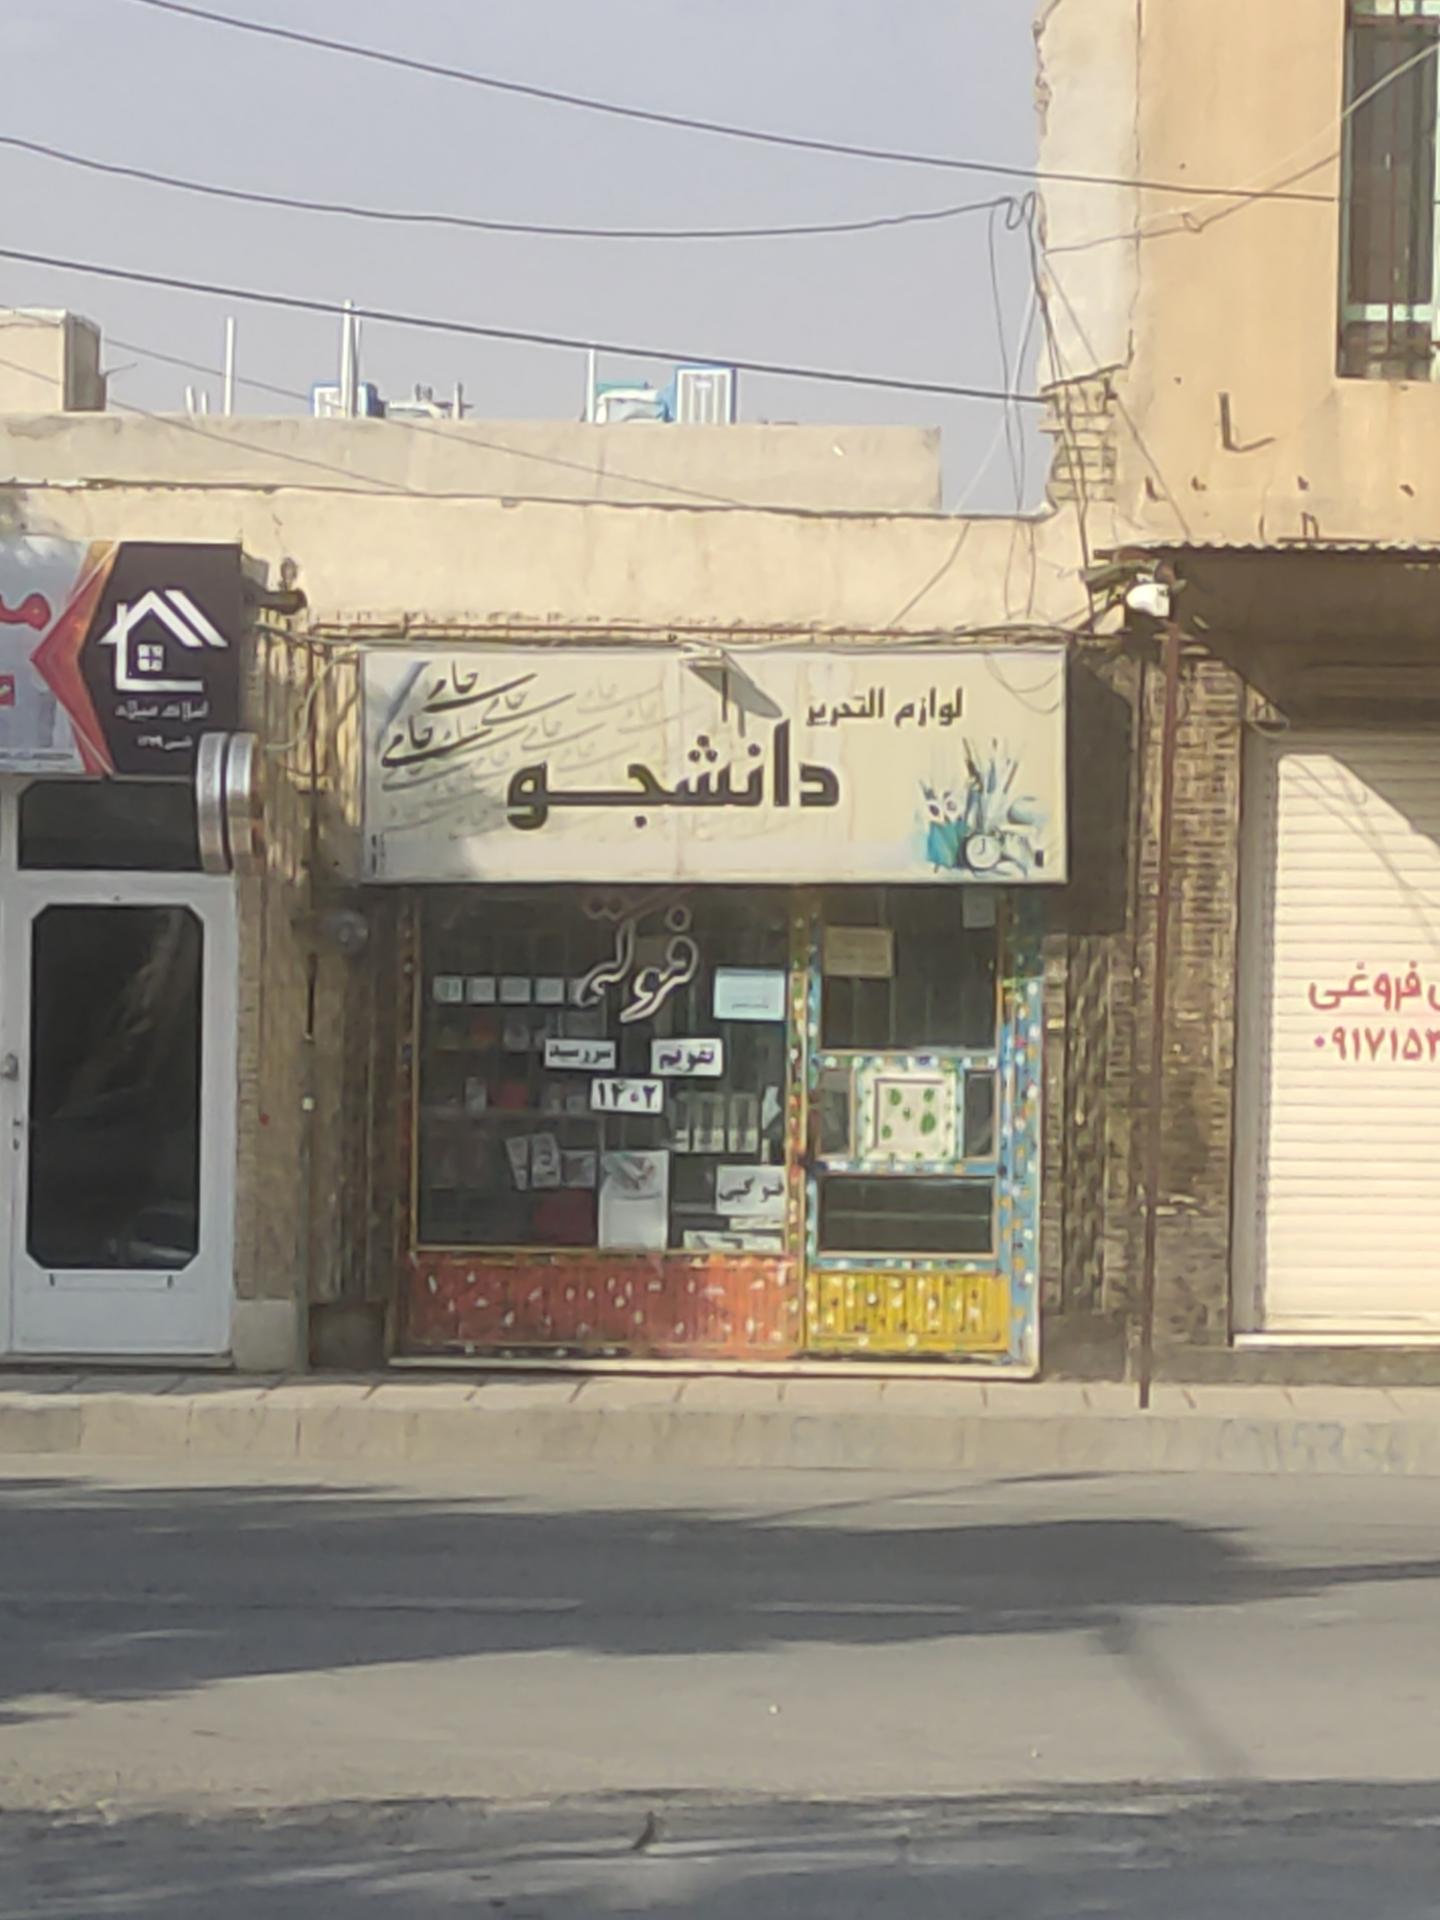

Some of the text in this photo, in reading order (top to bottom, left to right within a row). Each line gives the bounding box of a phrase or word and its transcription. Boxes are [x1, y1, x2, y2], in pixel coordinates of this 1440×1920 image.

[806, 687, 964, 728] لوازم التحریر
[507, 720, 840, 832] دانشجو
[1308, 960, 1422, 1012] فروغی
[658, 1047, 715, 1072] تقویم
[595, 1077, 656, 1106] ۱۴۰۲
